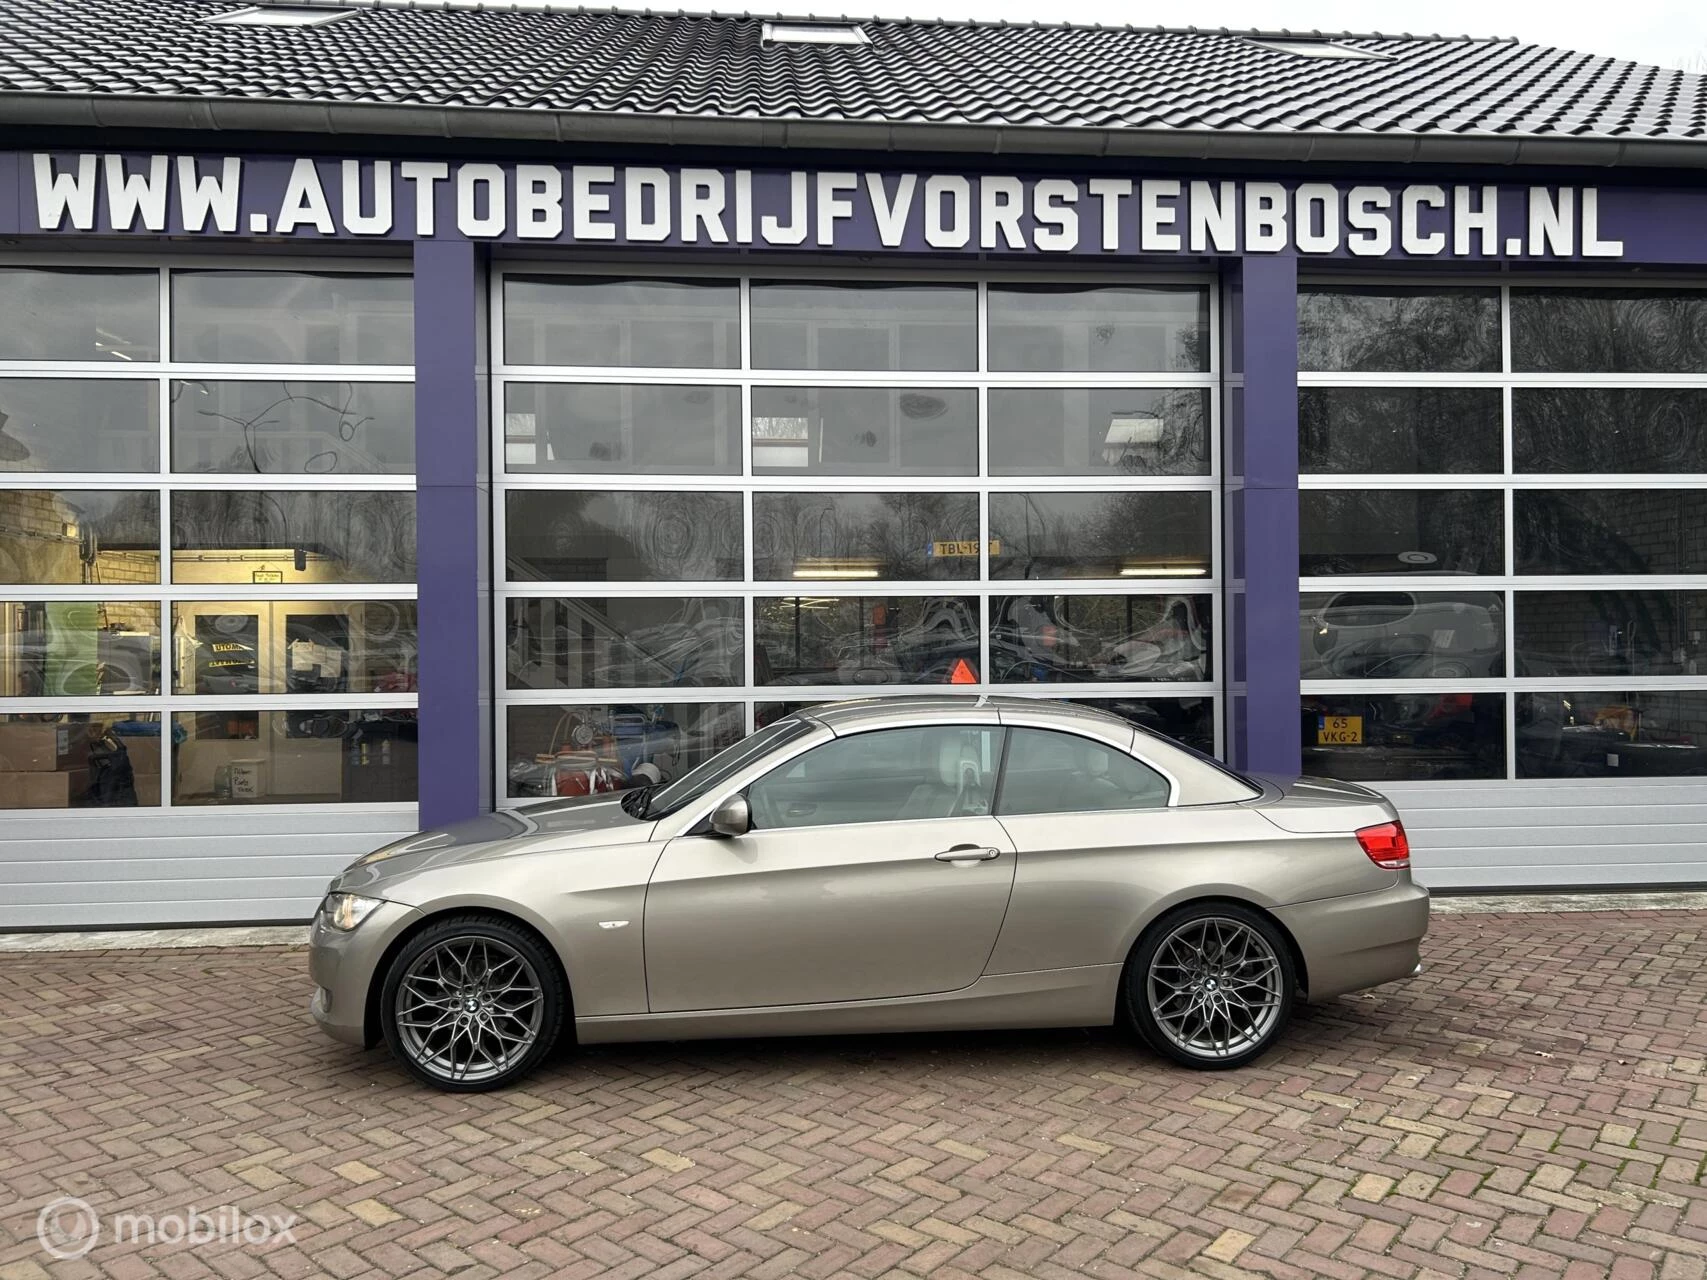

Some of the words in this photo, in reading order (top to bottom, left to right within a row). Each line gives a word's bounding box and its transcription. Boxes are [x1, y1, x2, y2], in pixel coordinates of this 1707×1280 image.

[33, 153, 1624, 258] WWW.AUTOBEDRIJFVORSTENBOSCH.NL
[1332, 718, 1348, 729] 65
[1323, 731, 1358, 742] VKG-2
